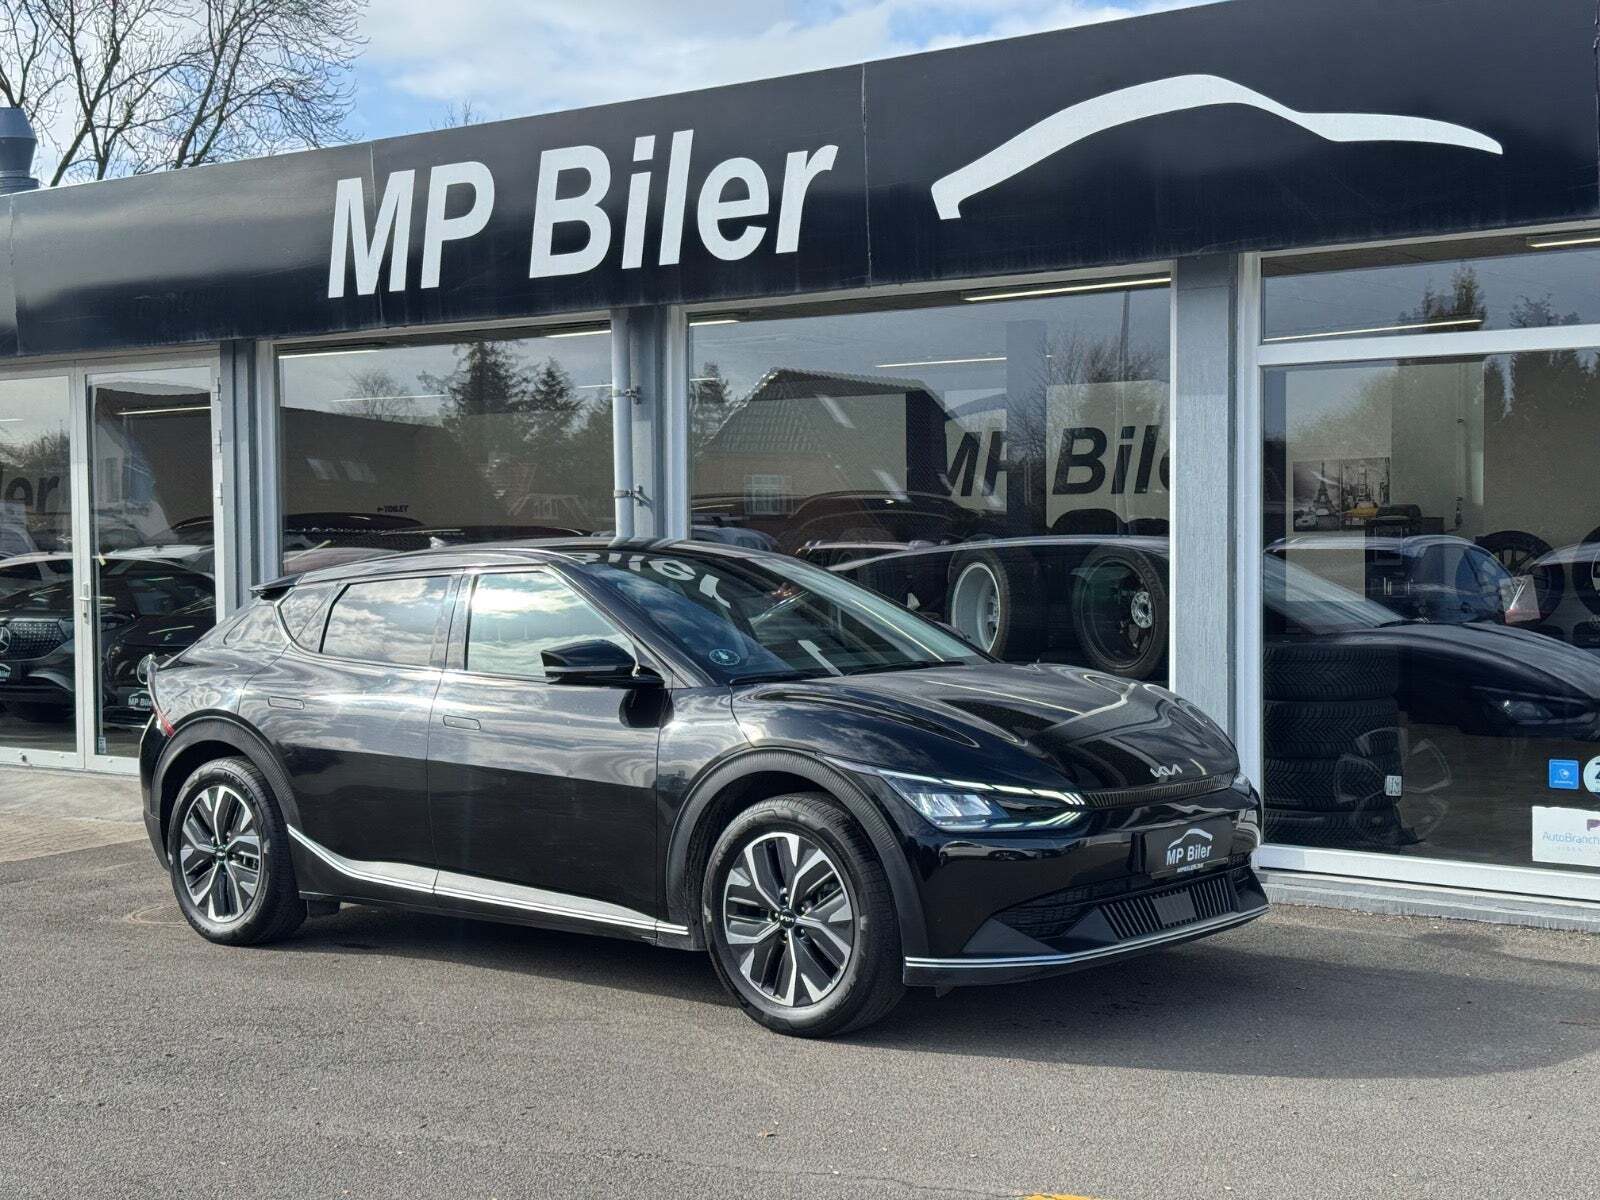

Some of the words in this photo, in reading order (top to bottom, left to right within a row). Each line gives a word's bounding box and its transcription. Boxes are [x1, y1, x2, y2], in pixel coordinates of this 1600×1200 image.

[328, 161, 494, 298] MP
[530, 129, 838, 278] Biler
[1166, 848, 1184, 865] MP
[1187, 844, 1212, 861] Biler
